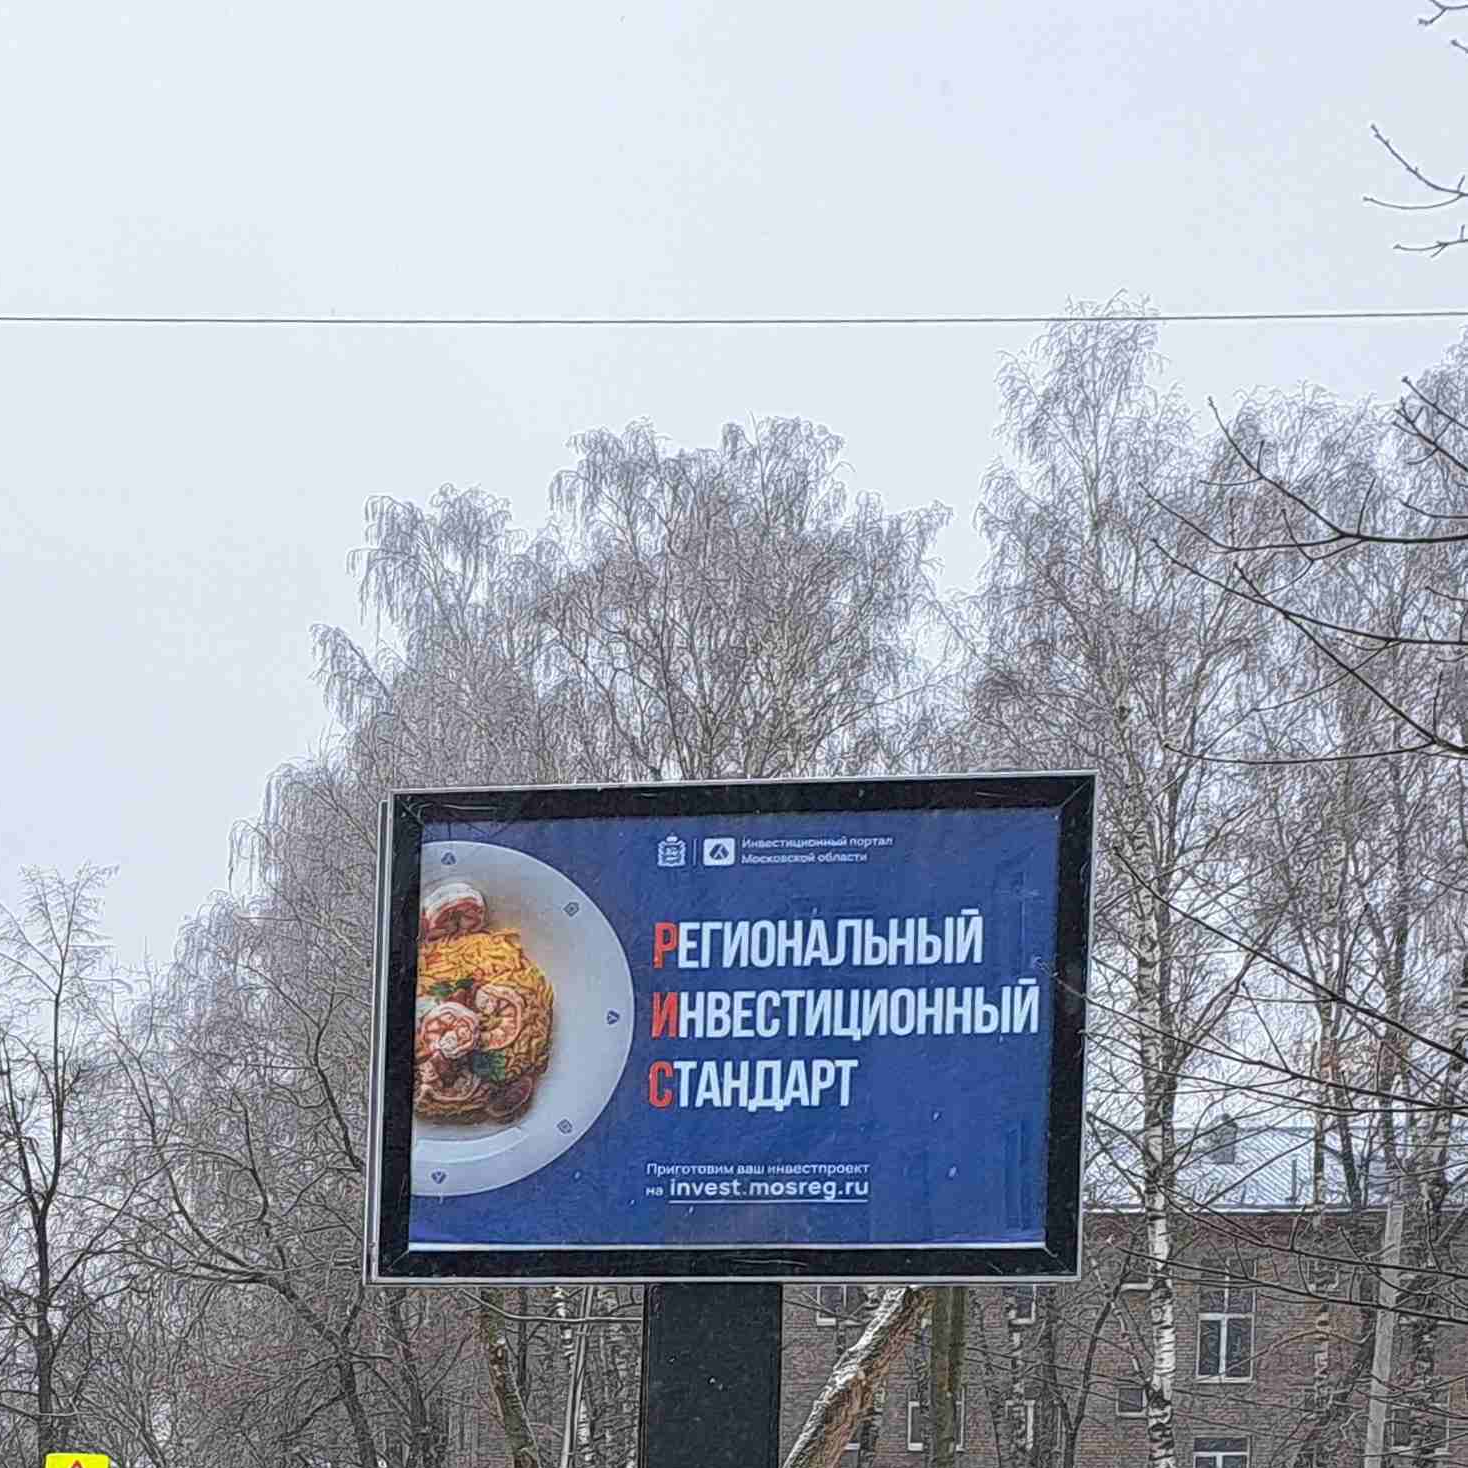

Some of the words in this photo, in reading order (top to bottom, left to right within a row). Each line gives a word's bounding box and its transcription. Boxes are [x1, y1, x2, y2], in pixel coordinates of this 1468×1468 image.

[742, 834, 847, 849] Инвестиционный
[849, 836, 894, 849] портал
[741, 851, 815, 864] Московской
[816, 851, 867, 863] области
[654, 907, 984, 969] РЕГИОНАЛЬНЫЙ
[651, 977, 1040, 1041] ИНВЕСТИЦИОННЫЙ
[648, 1057, 859, 1112] СТАНДАРТ
[646, 1162, 734, 1177] Приготовим
[737, 1164, 765, 1175] ваш
[767, 1163, 870, 1176] инвестпроект
[645, 1187, 664, 1197] на
[669, 1178, 870, 1200] invest.mosreg.ru
